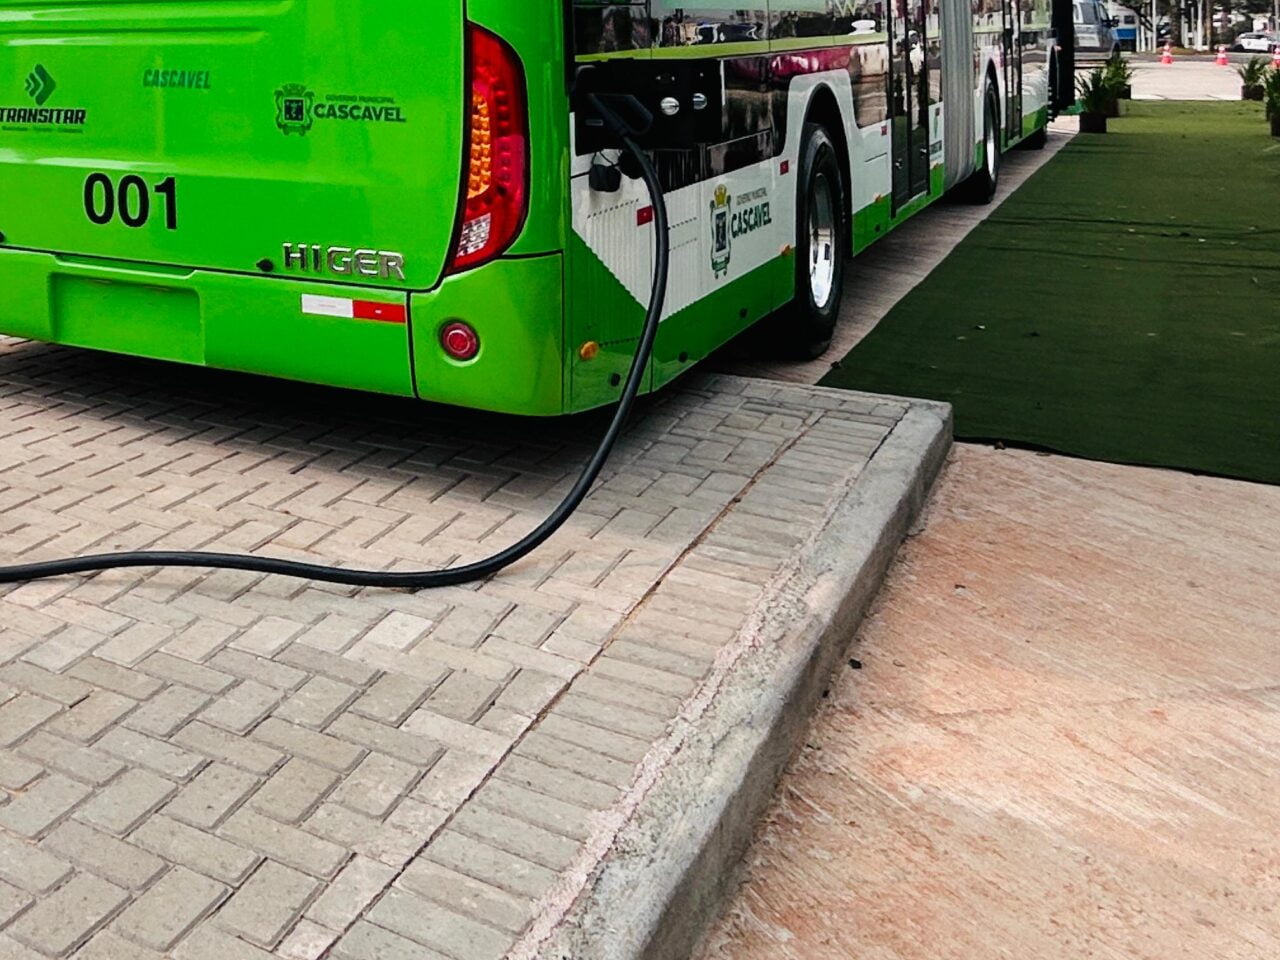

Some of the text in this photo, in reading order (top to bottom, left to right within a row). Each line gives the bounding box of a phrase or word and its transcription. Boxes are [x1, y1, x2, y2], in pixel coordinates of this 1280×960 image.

[142, 69, 212, 89] CASCAVEL
[313, 103, 407, 123] CASCAVEL
[84, 172, 177, 230] 001
[731, 201, 772, 239] CASCAVEL
[282, 242, 406, 280] HIGER
